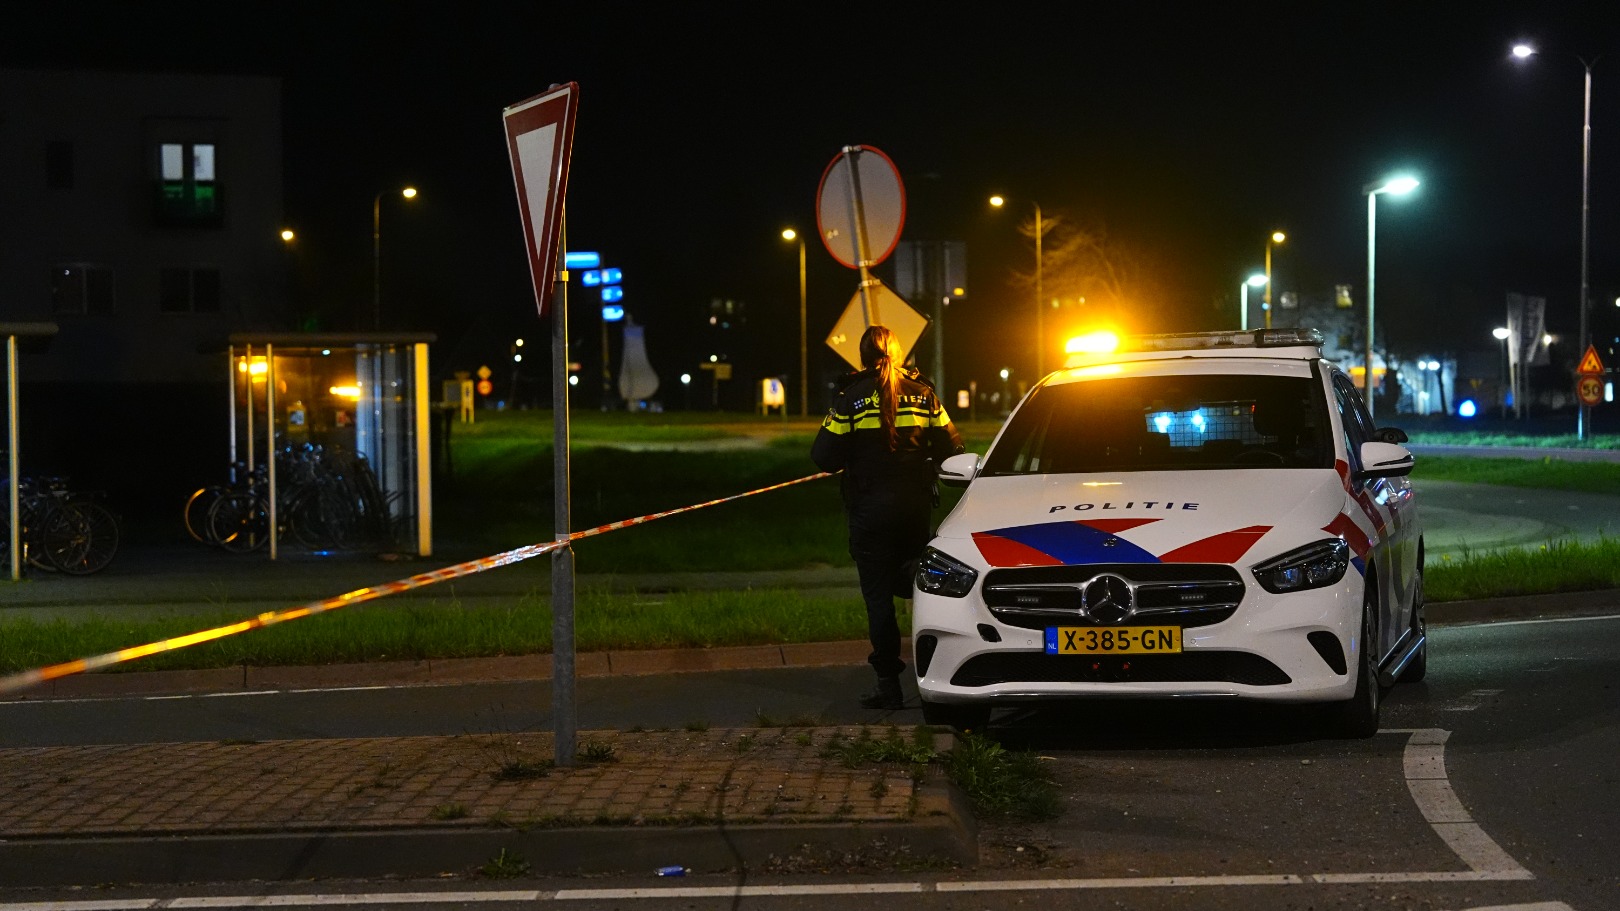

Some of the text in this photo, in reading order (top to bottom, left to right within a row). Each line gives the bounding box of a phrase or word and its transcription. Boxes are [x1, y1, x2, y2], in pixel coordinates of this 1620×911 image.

[1583, 384, 1601, 397] 50
[1049, 501, 1200, 514] POLITIE
[1064, 629, 1173, 651] X-385-GN
